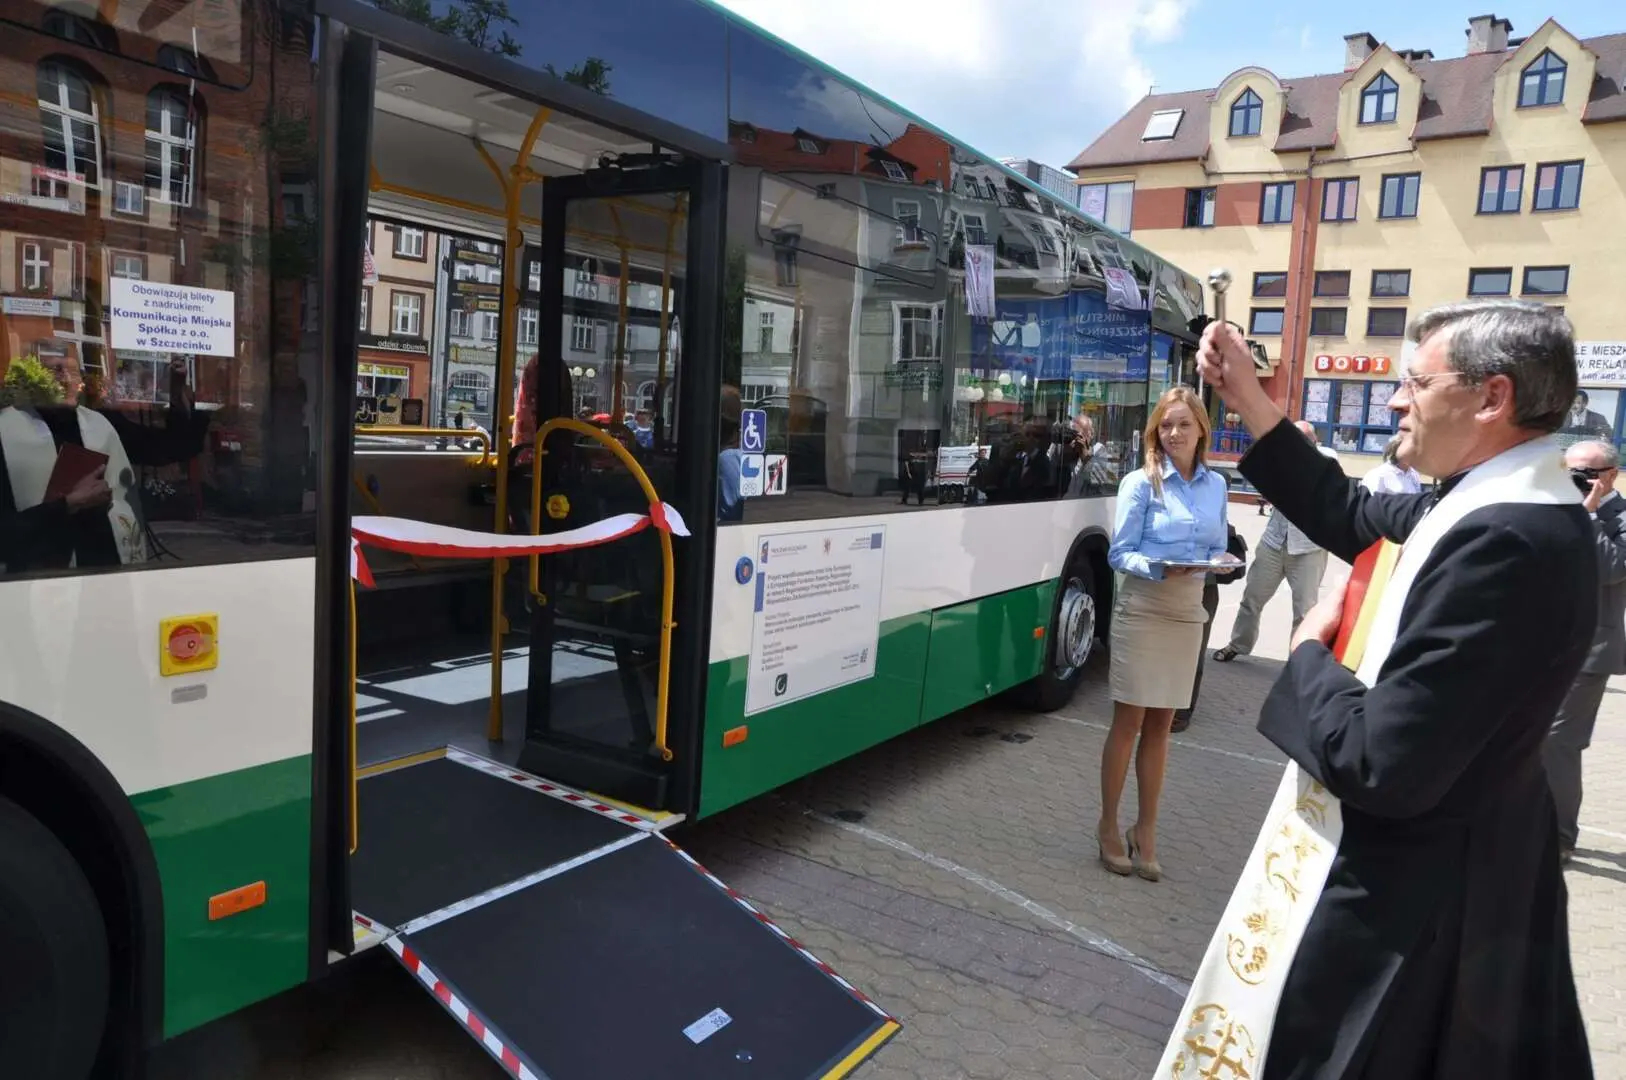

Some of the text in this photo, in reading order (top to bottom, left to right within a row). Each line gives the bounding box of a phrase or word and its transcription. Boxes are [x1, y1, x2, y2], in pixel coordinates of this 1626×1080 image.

[132, 285, 214, 304] Obowiązują bilety
[152, 300, 204, 312] nadrukiem:
[113, 307, 231, 328] Komunikacja Miejska
[138, 323, 177, 337] Spółka
[190, 330, 209, 338] o.o.
[136, 337, 212, 351] w Szczecinku
[1316, 356, 1386, 371] BOTI
